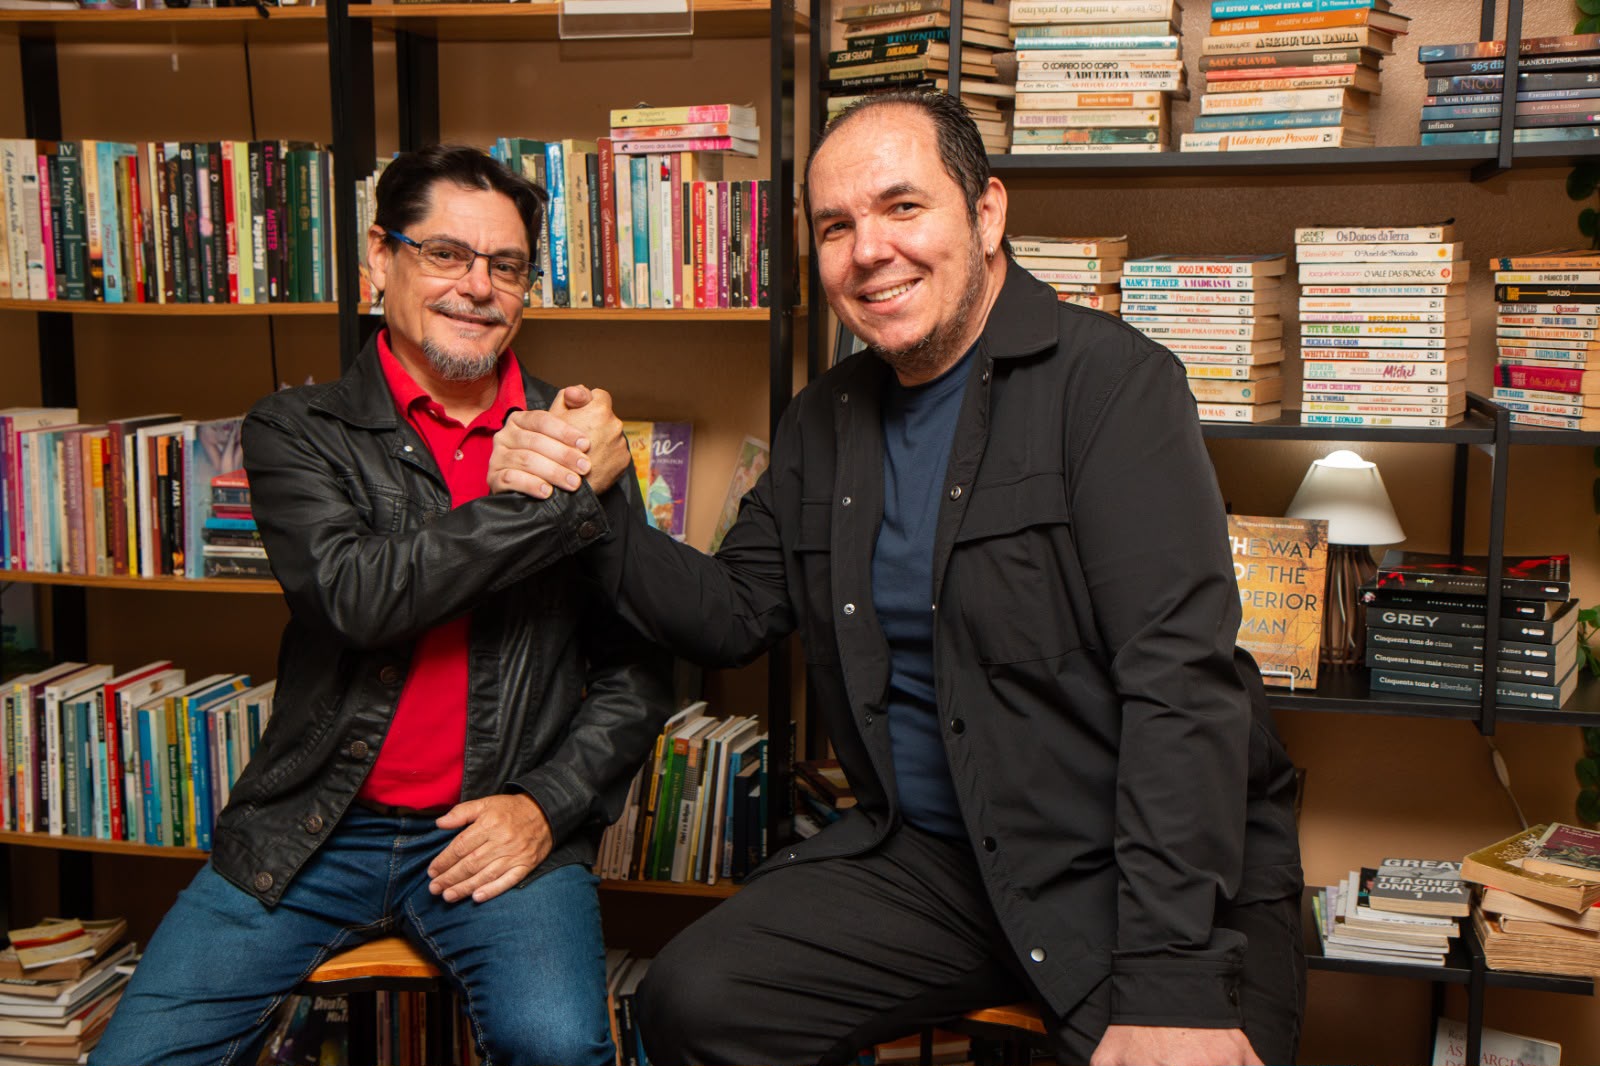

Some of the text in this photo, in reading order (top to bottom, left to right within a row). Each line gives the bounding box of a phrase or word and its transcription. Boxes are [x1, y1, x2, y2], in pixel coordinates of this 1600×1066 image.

[1226, 5, 1248, 13] ESTOU
[1471, 59, 1504, 72] 365 di
[266, 160, 274, 187] James
[63, 177, 76, 231] Professor
[266, 208, 278, 251] MISTER
[1336, 230, 1409, 241] Os Donos da Terra
[253, 215, 266, 270] Paperboy
[1130, 265, 1154, 273] ROBERT
[1177, 266, 1194, 274] JOGO
[1195, 266, 1205, 274] EM
[1125, 278, 1179, 288] NANCY THAYER
[172, 480, 181, 507] AFTAS
[1268, 540, 1319, 558] WAY
[1266, 565, 1307, 585] THE
[1240, 589, 1317, 611] PERIOR
[1241, 618, 1287, 635] MAN
[1382, 611, 1440, 628] GREY
[1374, 634, 1409, 644] Cinquenta
[1409, 637, 1423, 645] tons
[1424, 638, 1434, 647] de
[1375, 654, 1409, 664] Cinquenta
[1410, 656, 1425, 665] tons
[1426, 659, 1442, 667] mais
[1379, 676, 1414, 686] Cinquenta
[1430, 680, 1440, 689] de
[1377, 883, 1463, 894] ONIZUKA
